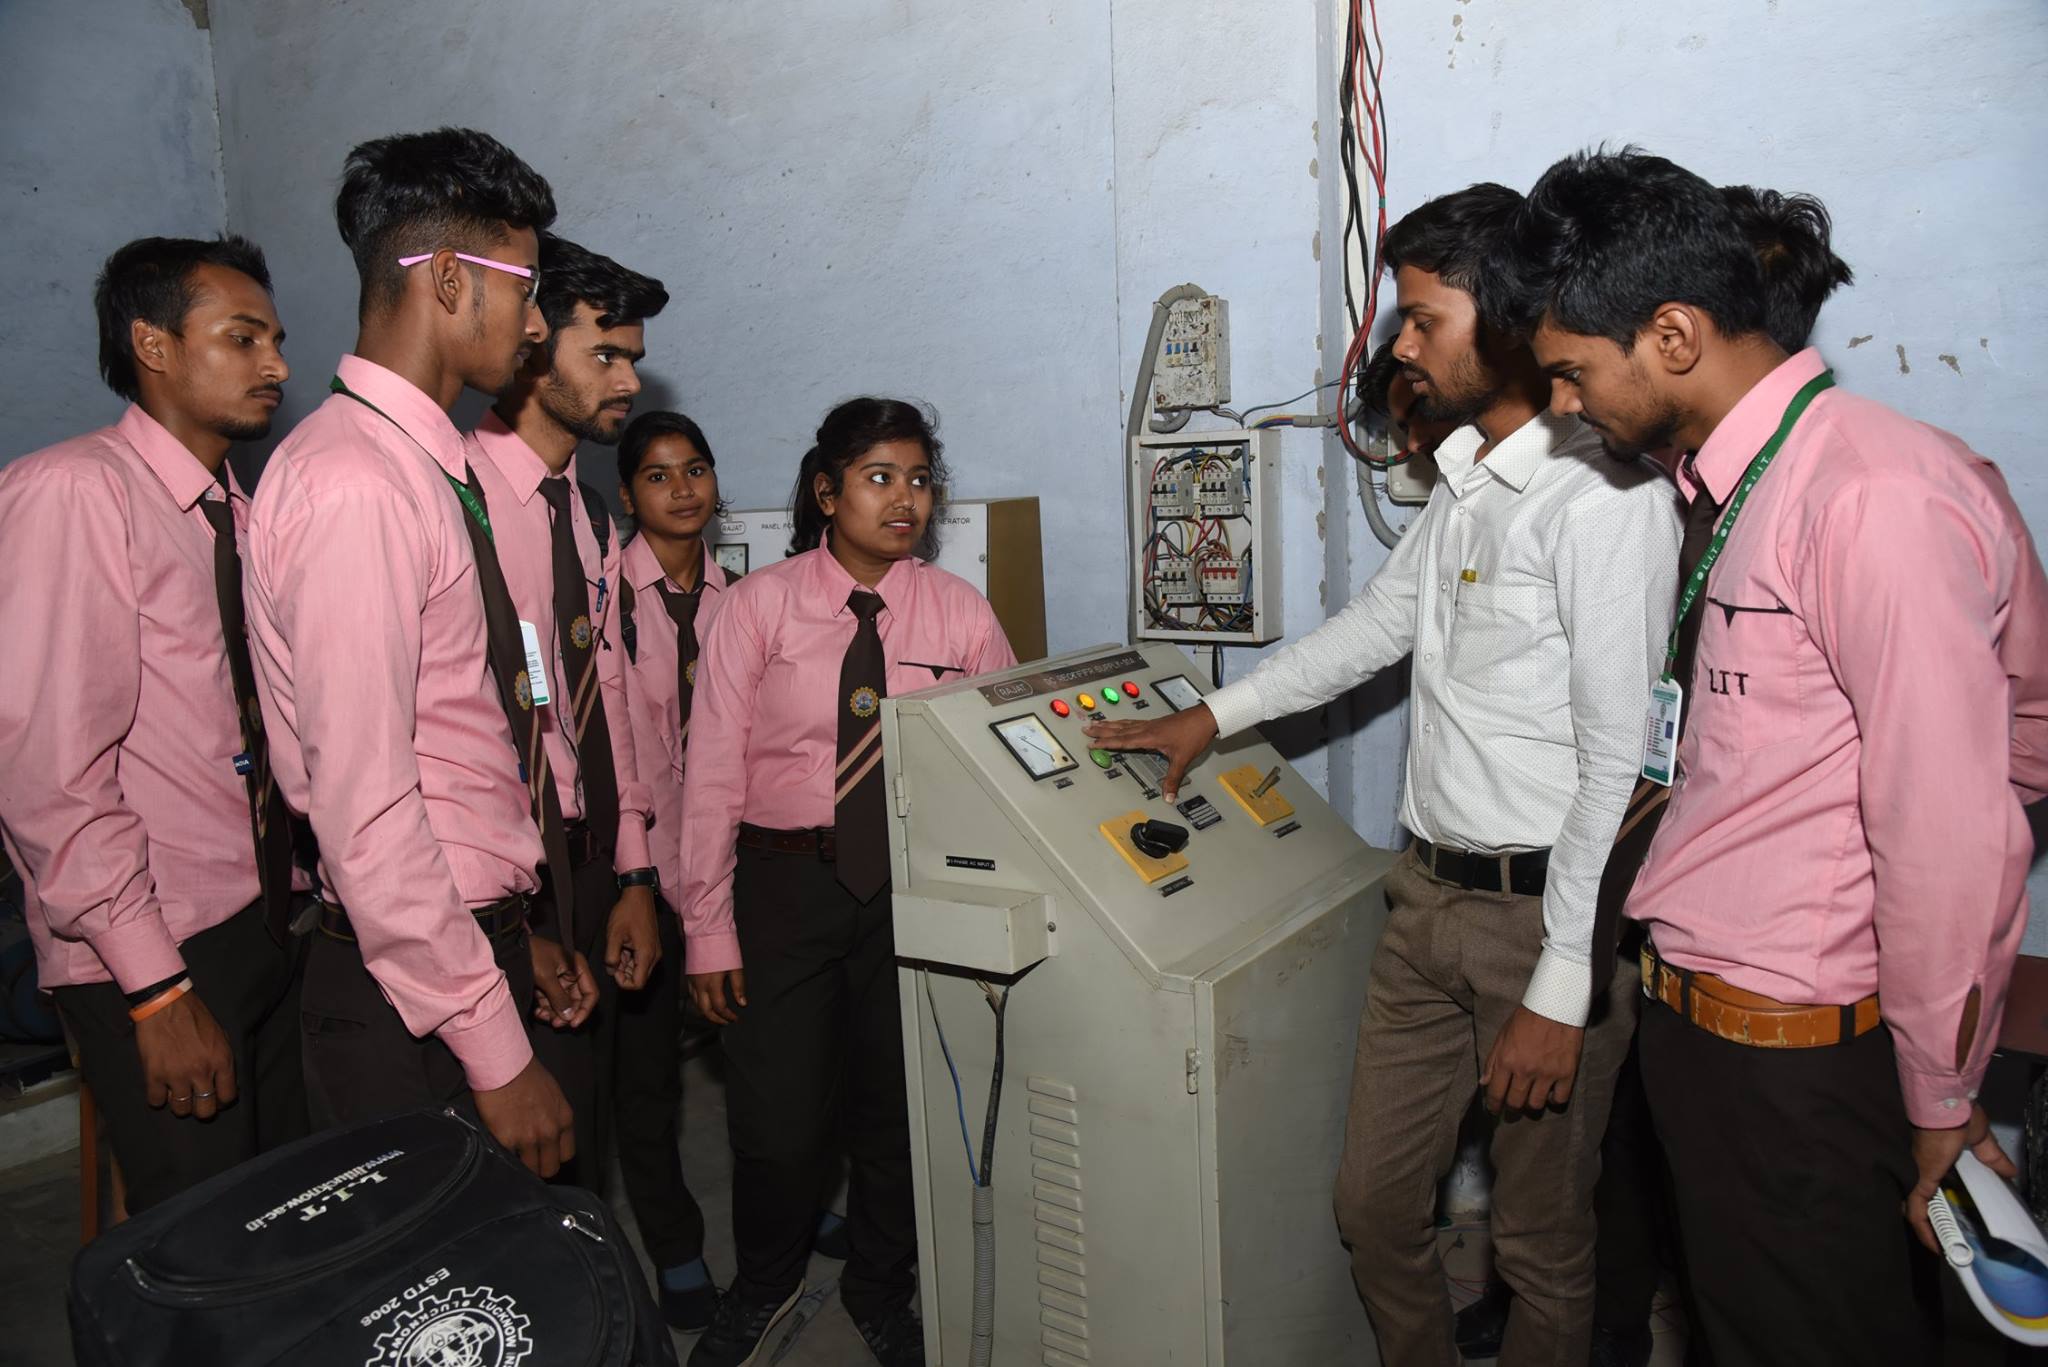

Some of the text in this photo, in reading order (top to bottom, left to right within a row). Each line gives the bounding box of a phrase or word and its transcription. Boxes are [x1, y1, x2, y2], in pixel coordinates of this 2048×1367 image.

[1709, 668, 1749, 696] LIT
[360, 1267, 451, 1327] ESTD 2008
[391, 1300, 460, 1349] LUCKNOW
[478, 1299, 517, 1348] LUCKNOW
